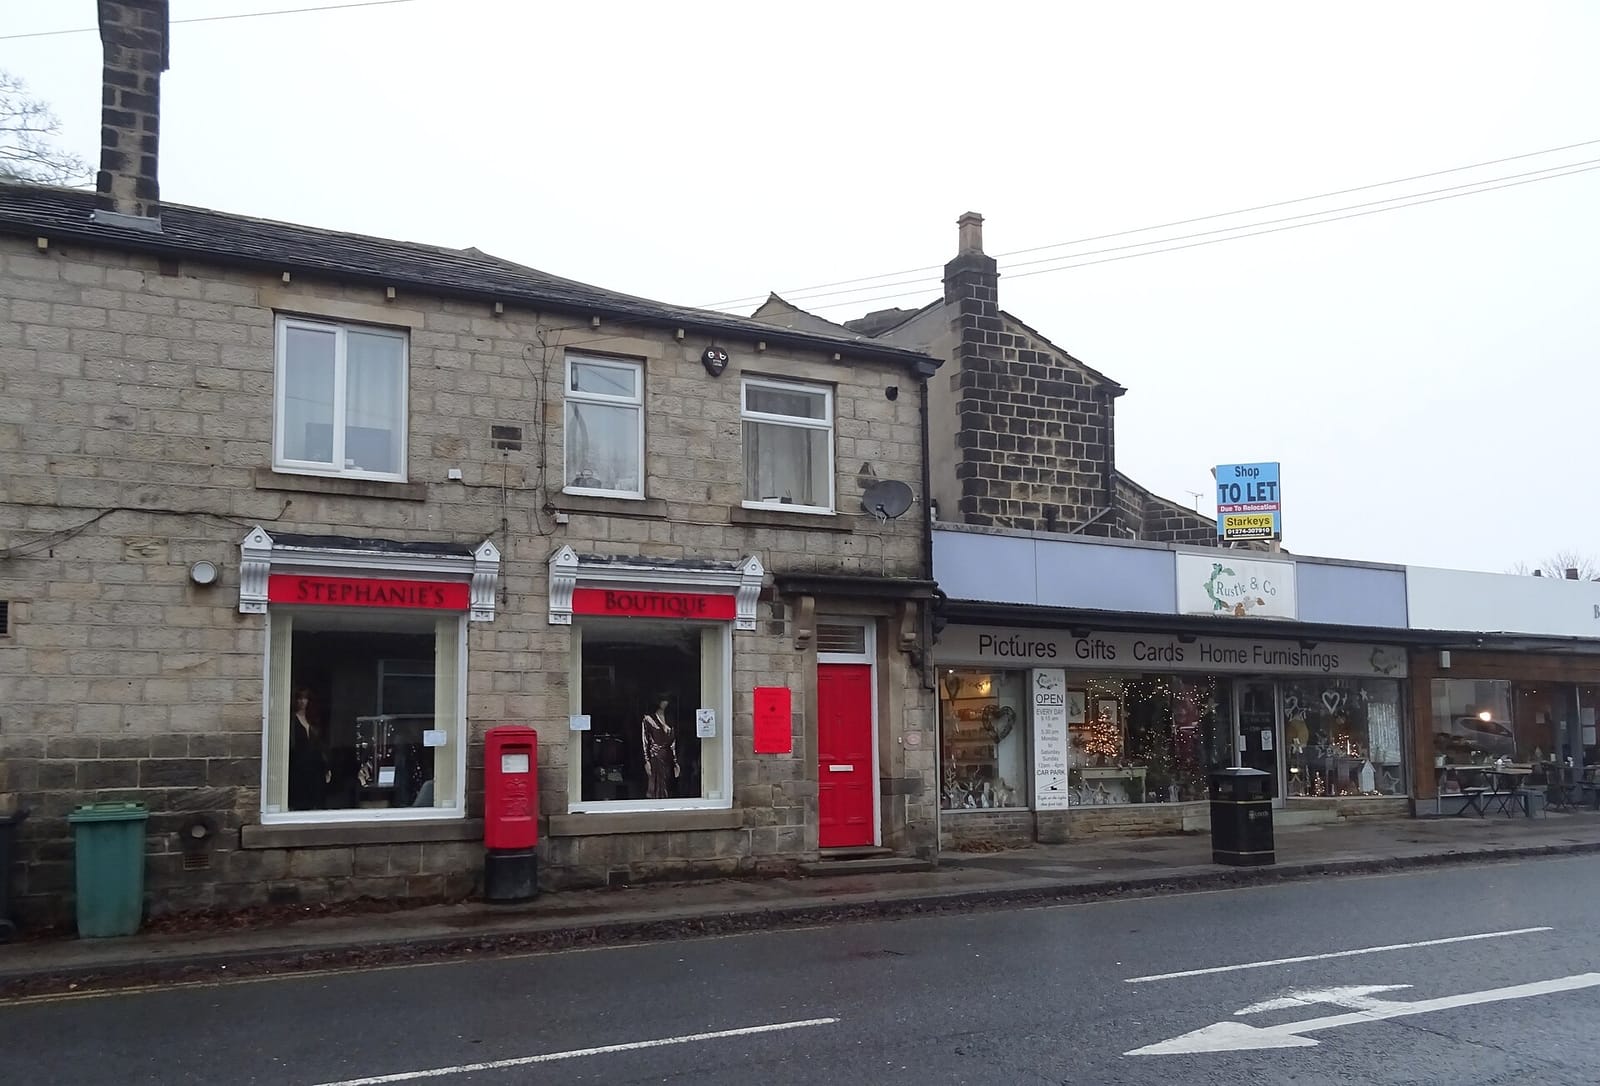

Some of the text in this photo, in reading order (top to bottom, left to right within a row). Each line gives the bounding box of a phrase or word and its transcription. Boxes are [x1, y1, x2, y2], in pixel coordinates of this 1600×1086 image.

[1235, 466, 1259, 479] Shop
[1219, 481, 1277, 503] TO LET
[1243, 503, 1277, 511] Relocation
[1226, 517, 1270, 527] Starkeys
[297, 579, 445, 605] STEPHANIE'S
[1250, 577, 1259, 591] &
[1263, 580, 1277, 596] Co
[604, 591, 707, 615] BOUTIQUE
[979, 634, 1339, 672] Pictures Gifts Cards Home Furnishings
[1036, 693, 1064, 704] OPEN
[1036, 708, 1064, 716] EVERY DAY
